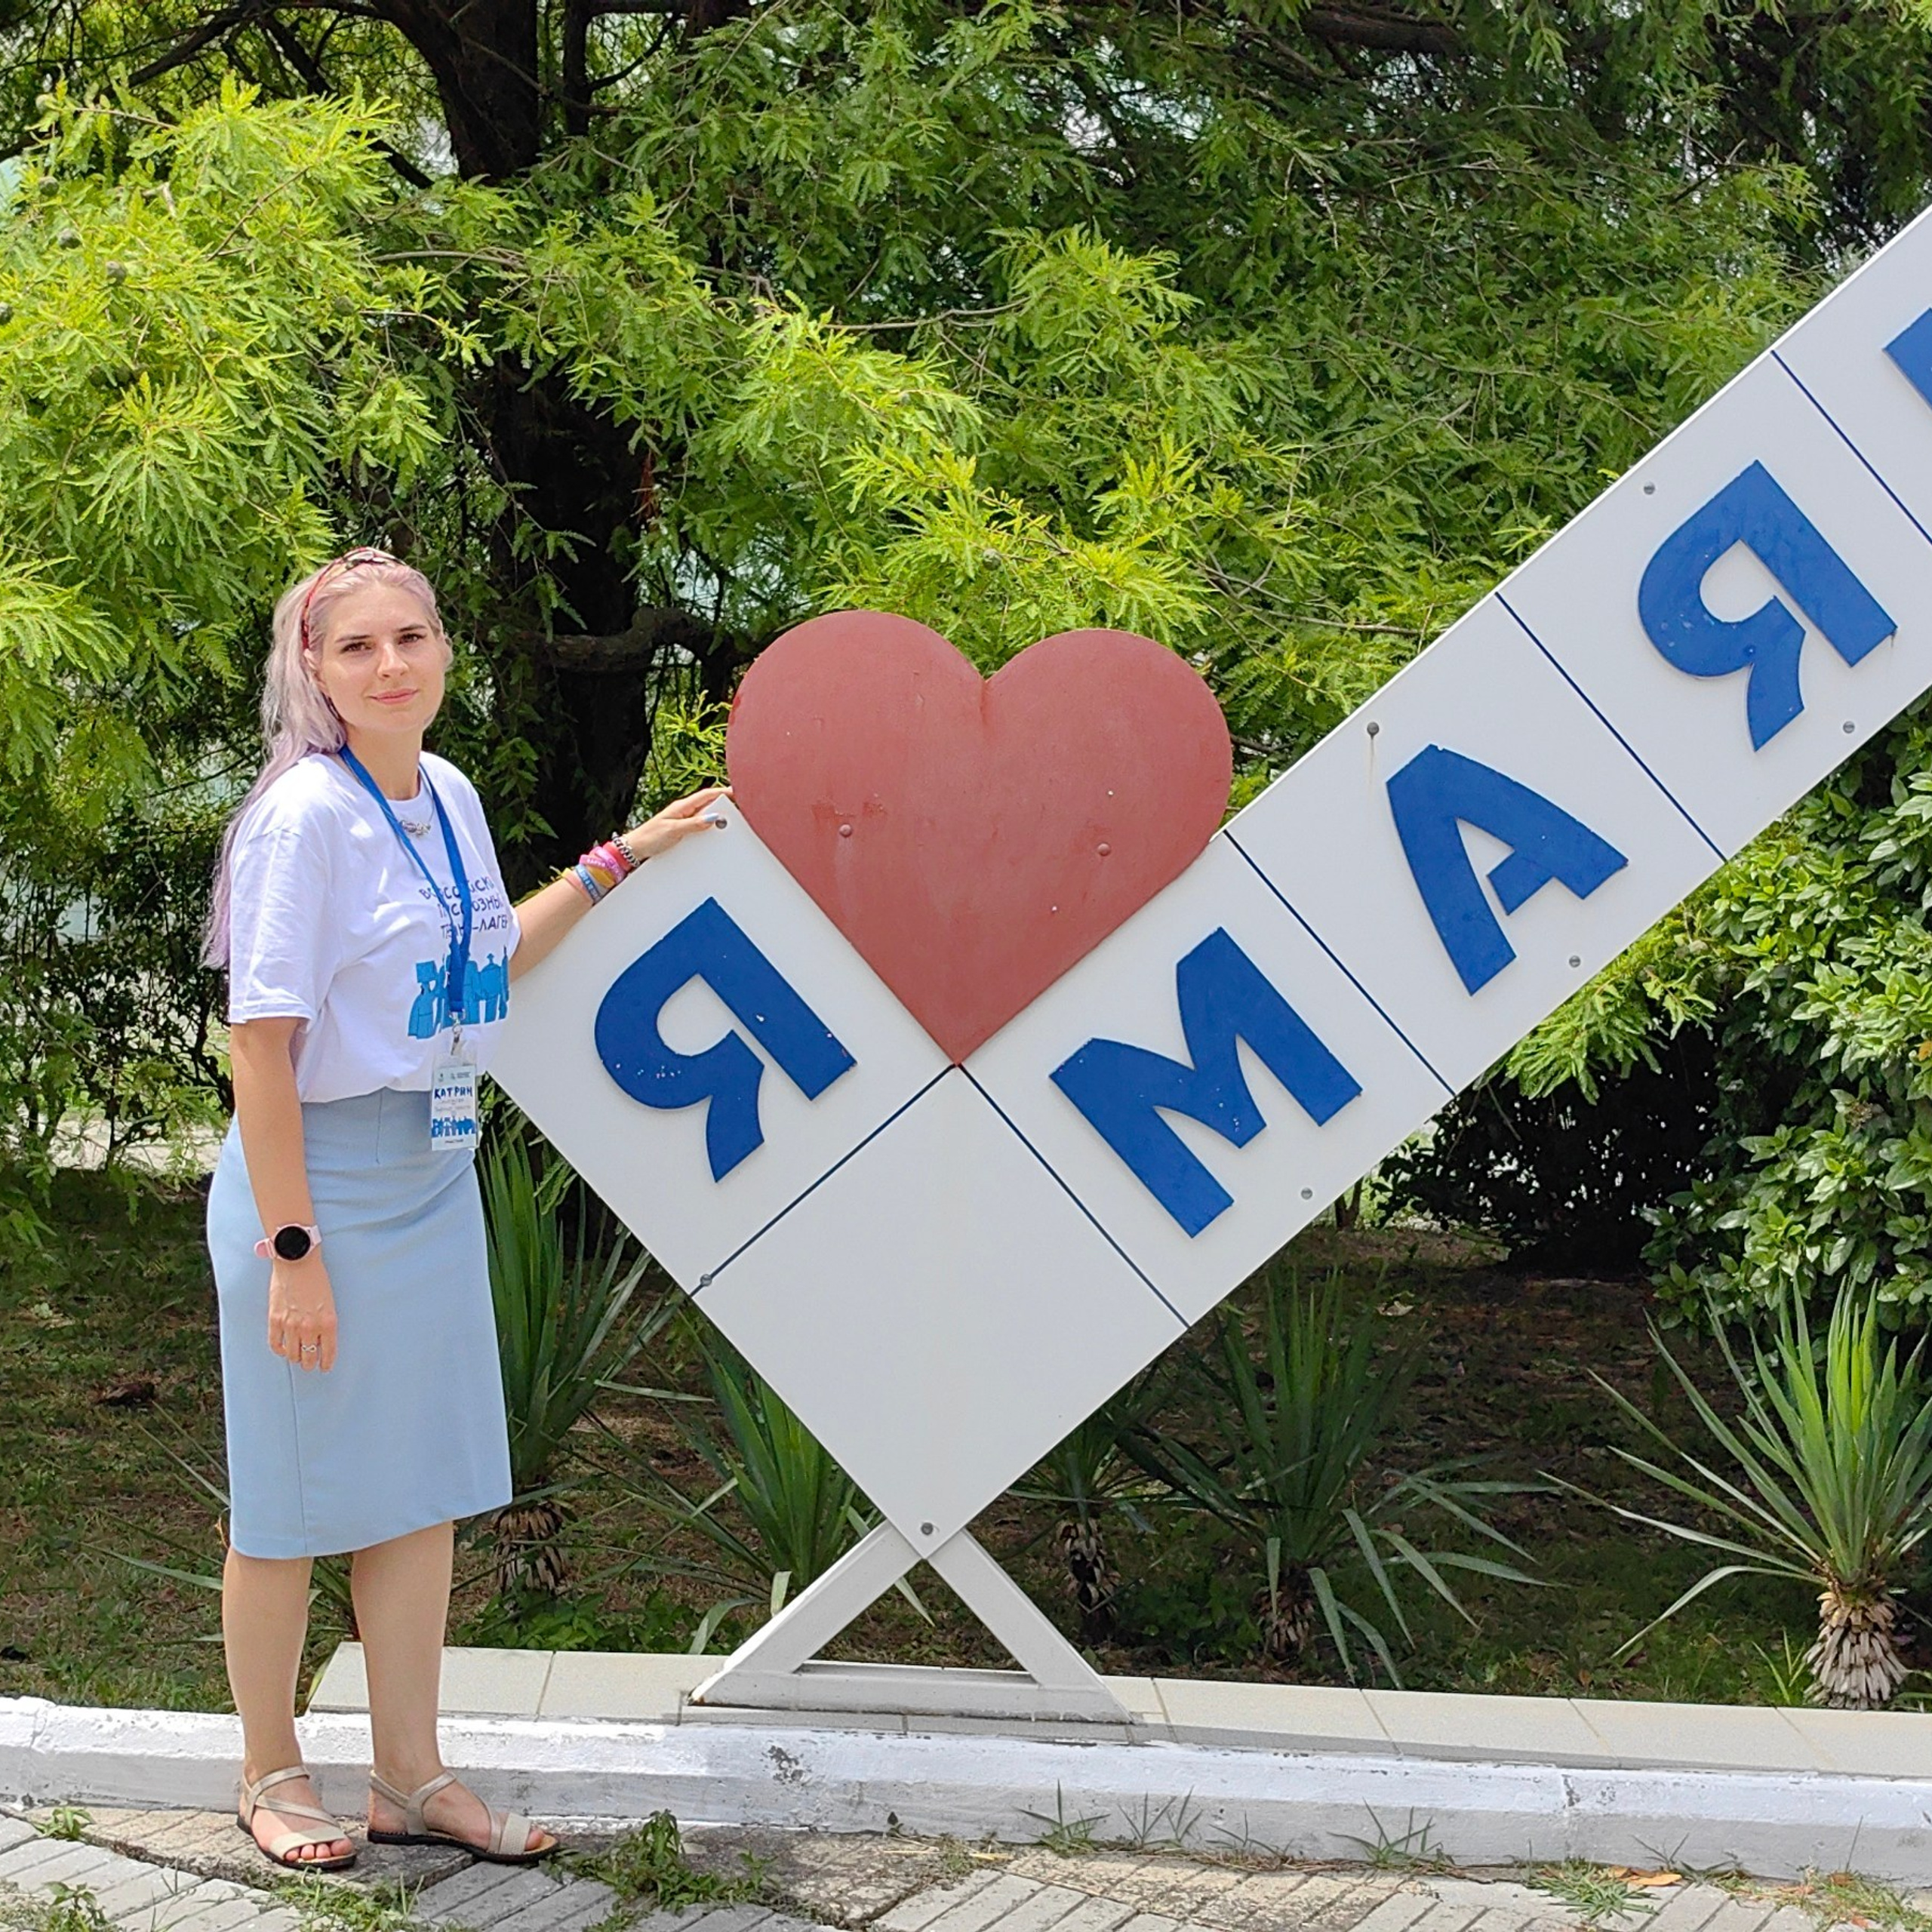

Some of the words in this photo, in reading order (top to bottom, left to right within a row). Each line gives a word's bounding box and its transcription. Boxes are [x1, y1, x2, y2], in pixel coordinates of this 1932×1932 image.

[595, 896, 857, 1183] Я
[1049, 307, 1932, 1239] МАЯ
[434, 1085, 472, 1100] КАТРИН
